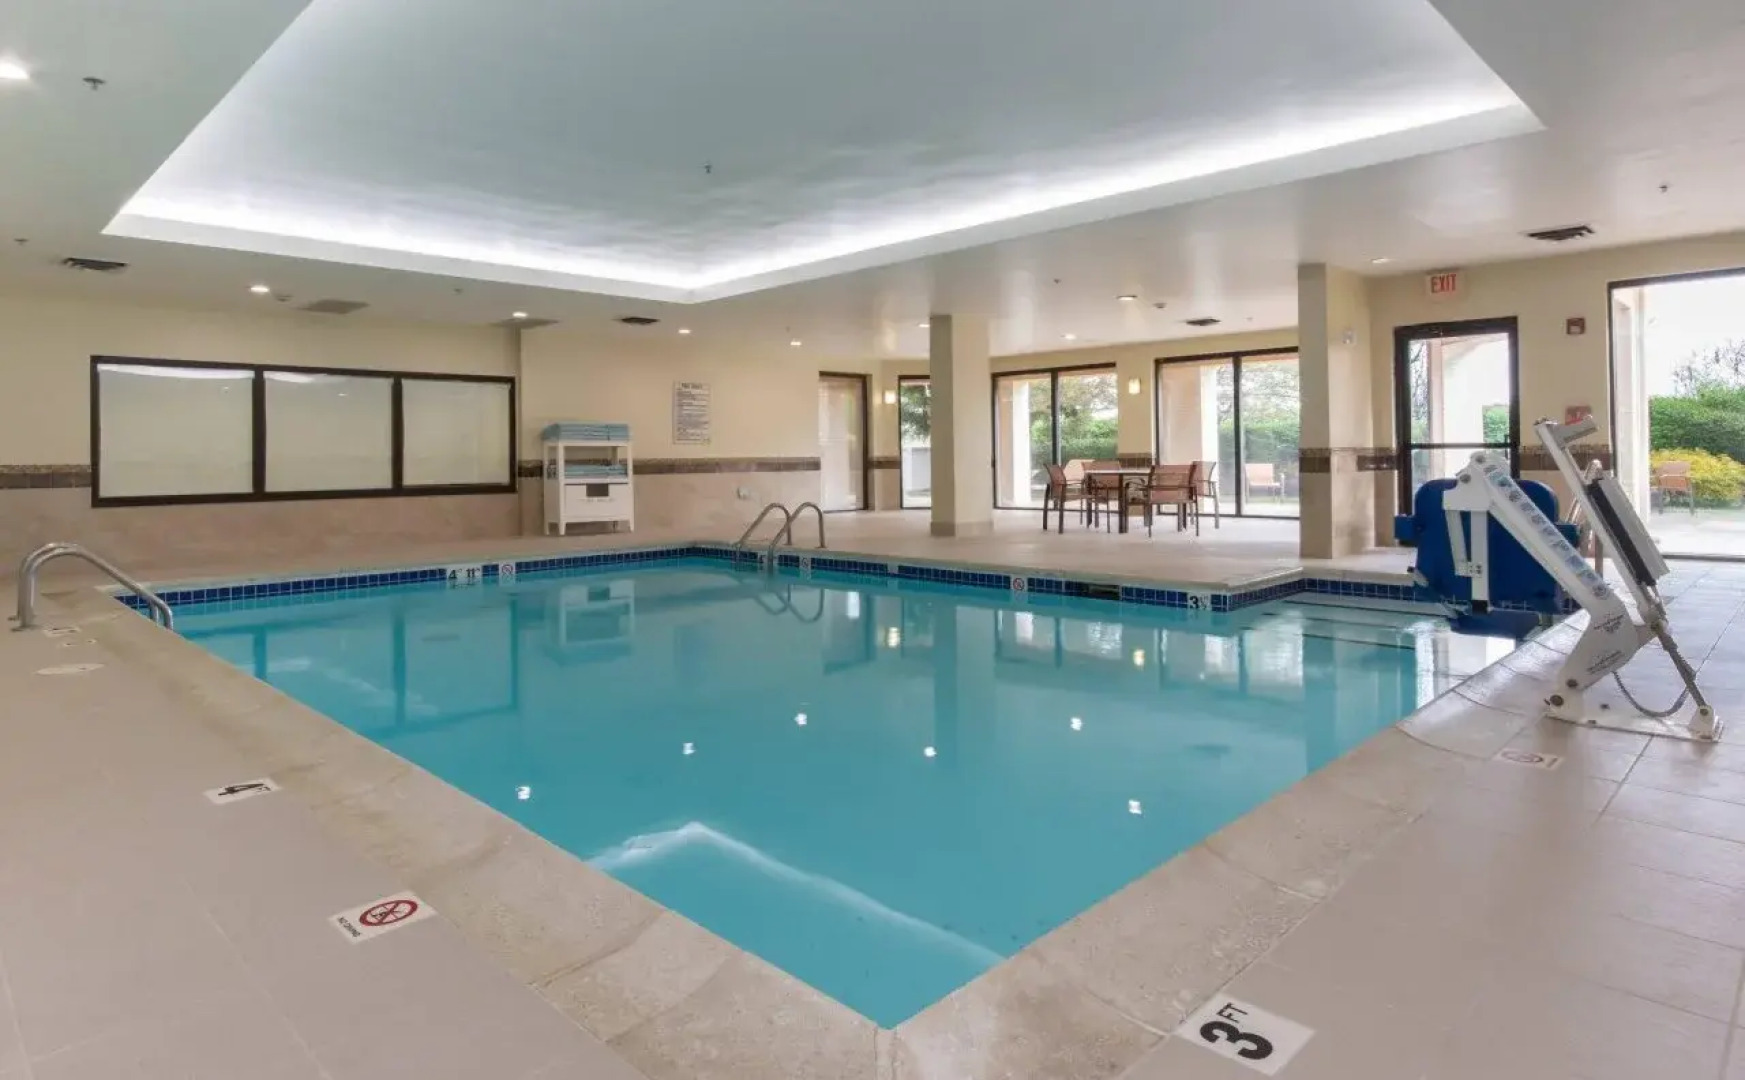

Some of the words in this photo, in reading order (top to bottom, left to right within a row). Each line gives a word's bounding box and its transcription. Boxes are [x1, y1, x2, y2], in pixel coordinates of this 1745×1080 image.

[1431, 273, 1457, 293] EXIT
[1216, 1002, 1248, 1024] FT
[1199, 1020, 1273, 1060] 3
